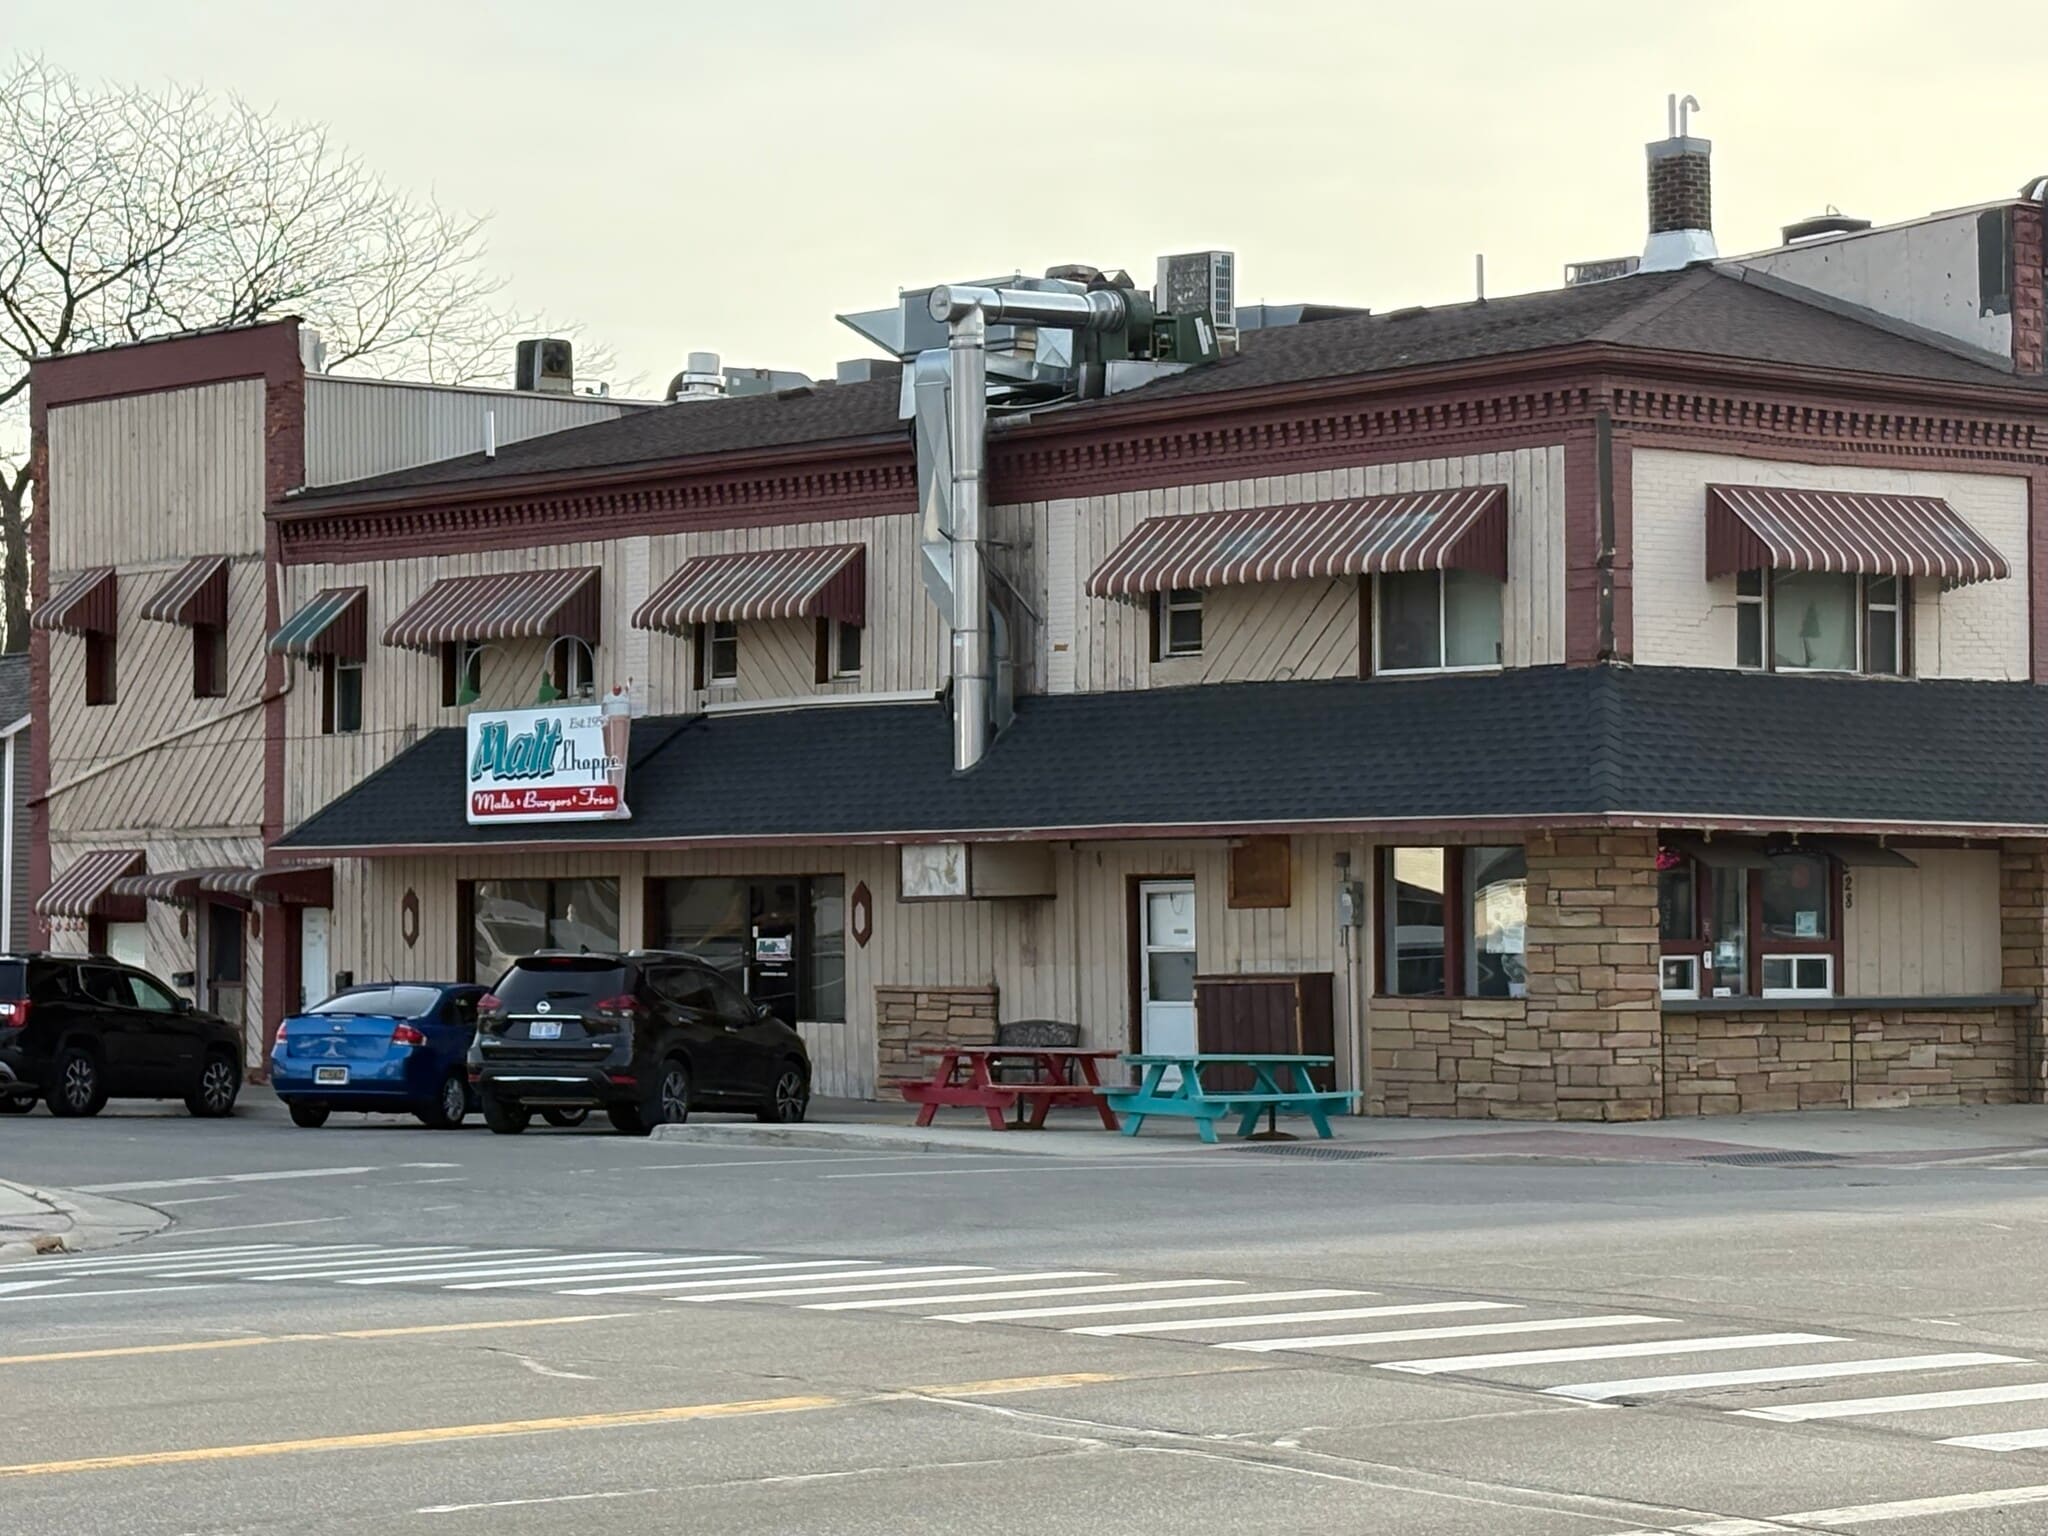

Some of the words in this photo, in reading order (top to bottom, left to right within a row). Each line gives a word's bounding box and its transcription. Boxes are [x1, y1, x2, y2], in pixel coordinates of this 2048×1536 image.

[472, 717, 562, 782] Malt
[557, 739, 623, 780] Shoppe
[475, 793, 515, 811] Malts
[522, 789, 572, 811] Burgers
[579, 787, 615, 806] Fries
